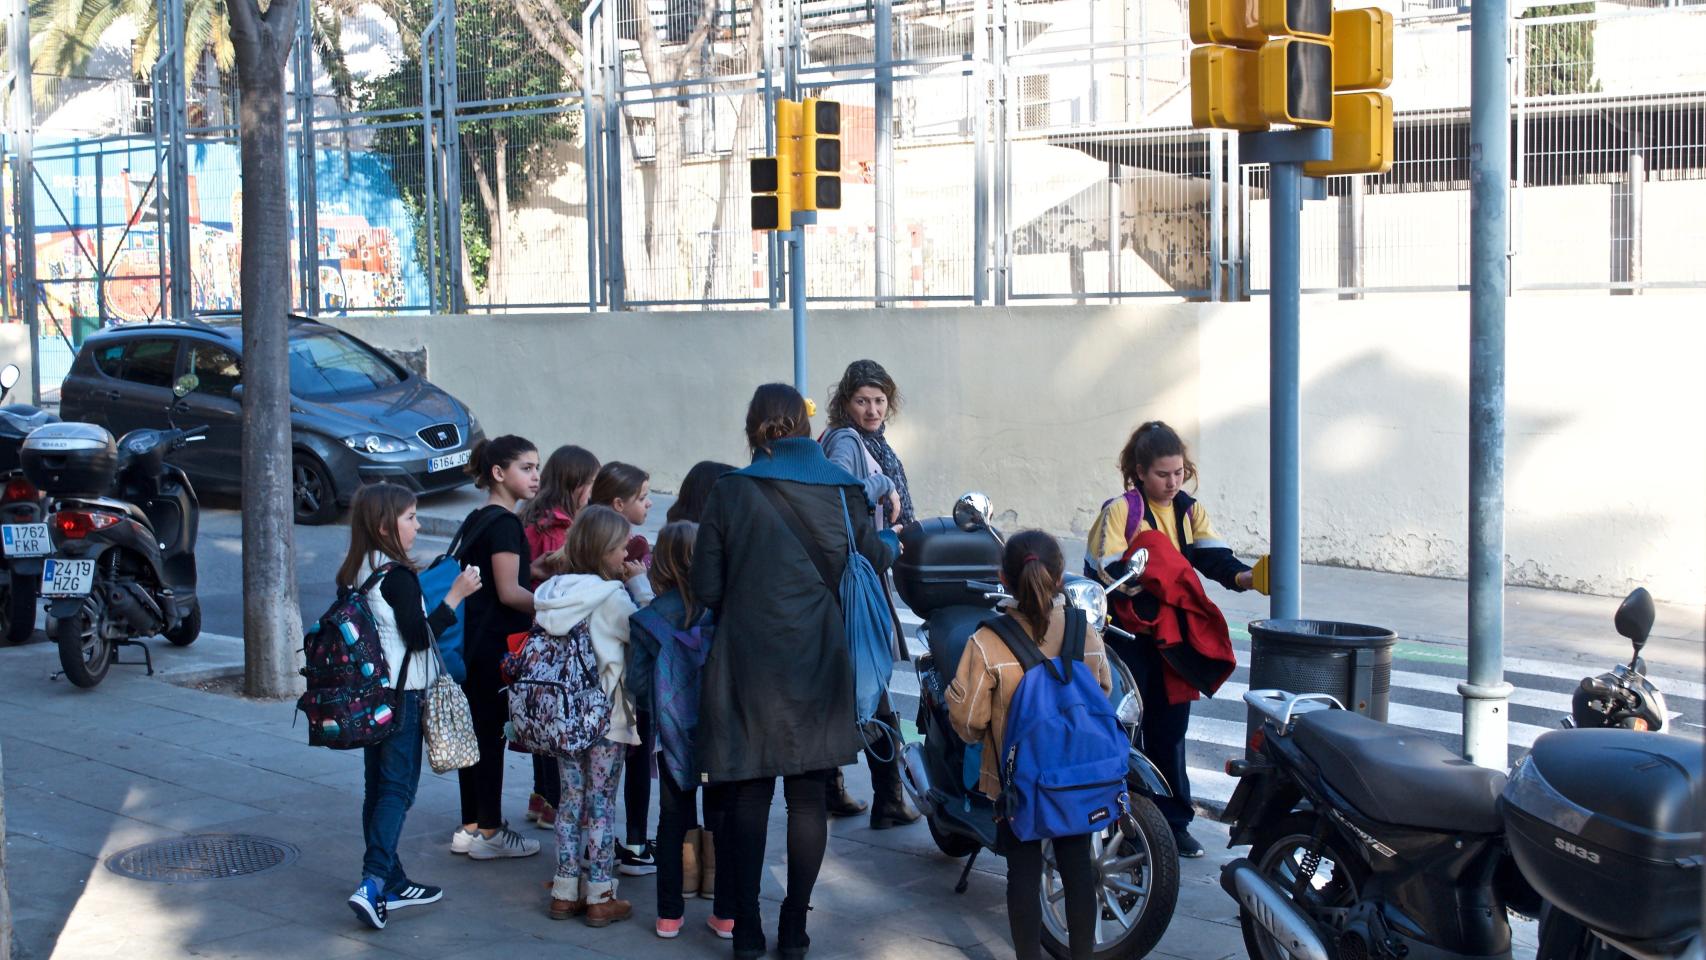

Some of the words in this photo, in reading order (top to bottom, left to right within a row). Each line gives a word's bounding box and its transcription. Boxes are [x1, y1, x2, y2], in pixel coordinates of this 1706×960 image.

[433, 456, 454, 469] 6164
[15, 526, 45, 539] 1762
[15, 540, 39, 552] FKR
[55, 561, 91, 576] 2419
[52, 577, 80, 591] HZG
[1554, 837, 1600, 864] SH33
